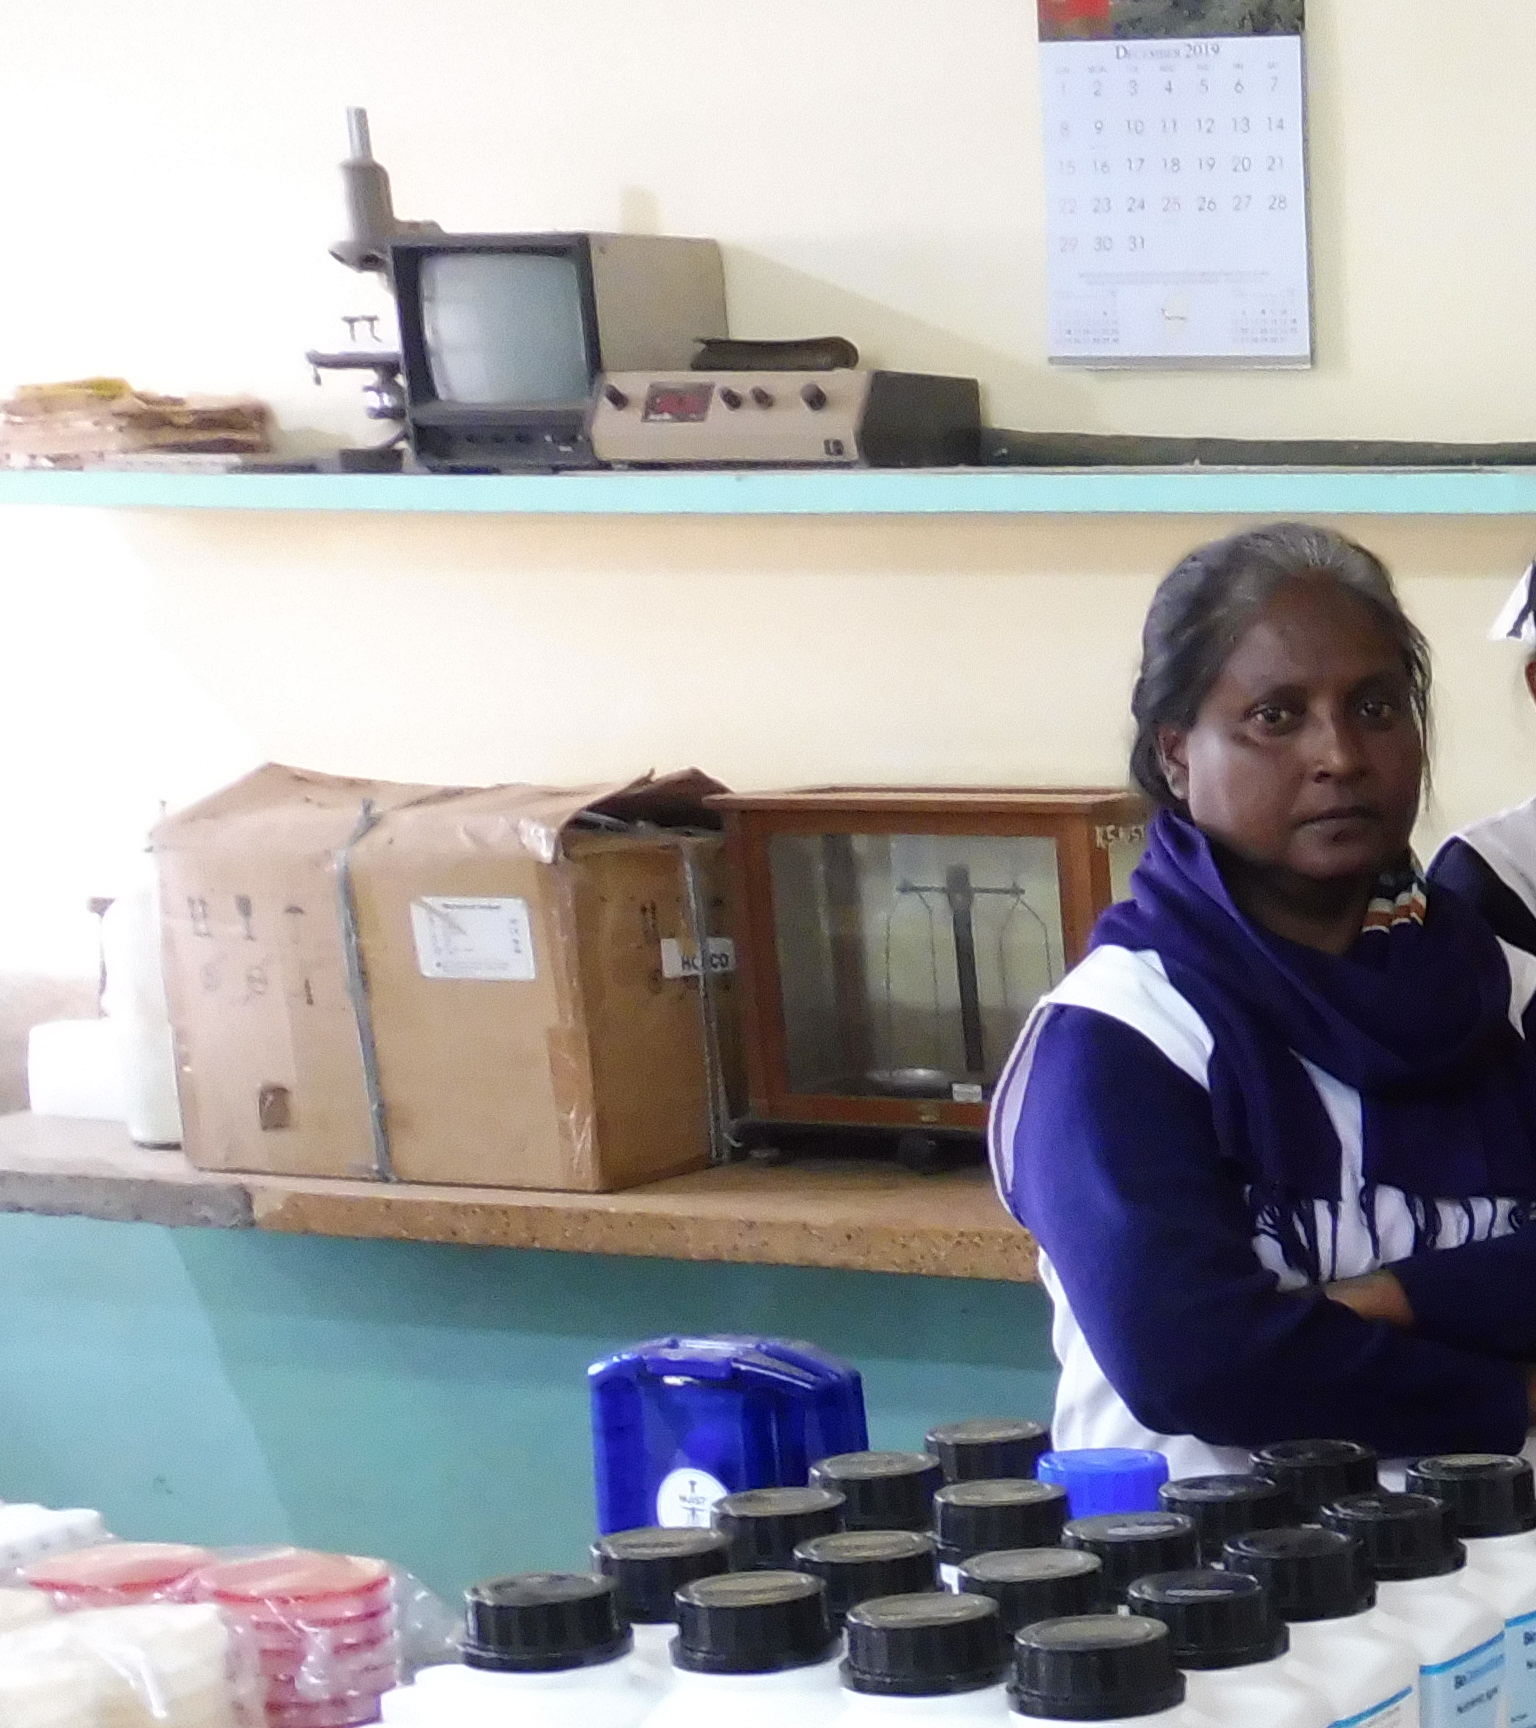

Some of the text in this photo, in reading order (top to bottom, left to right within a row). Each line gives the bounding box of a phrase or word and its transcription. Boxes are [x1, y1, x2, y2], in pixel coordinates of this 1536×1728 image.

[1185, 43, 1221, 59] 2019
[1093, 81, 1102, 96] 2
[1128, 80, 1138, 96] 3
[1164, 80, 1173, 93] 4
[1200, 79, 1209, 93] 5
[1234, 79, 1244, 93] 6
[1094, 117, 1285, 135] 9 10 11 12 13 14
[1094, 156, 1284, 174] 16 17 18 19 20 21
[1093, 197, 1112, 213] 23
[1127, 197, 1146, 212] 24
[1198, 197, 1217, 211] 26
[1232, 195, 1252, 211] 27
[1268, 195, 1287, 210] 28
[1094, 236, 1112, 252] 30
[1128, 236, 1145, 252] 31
